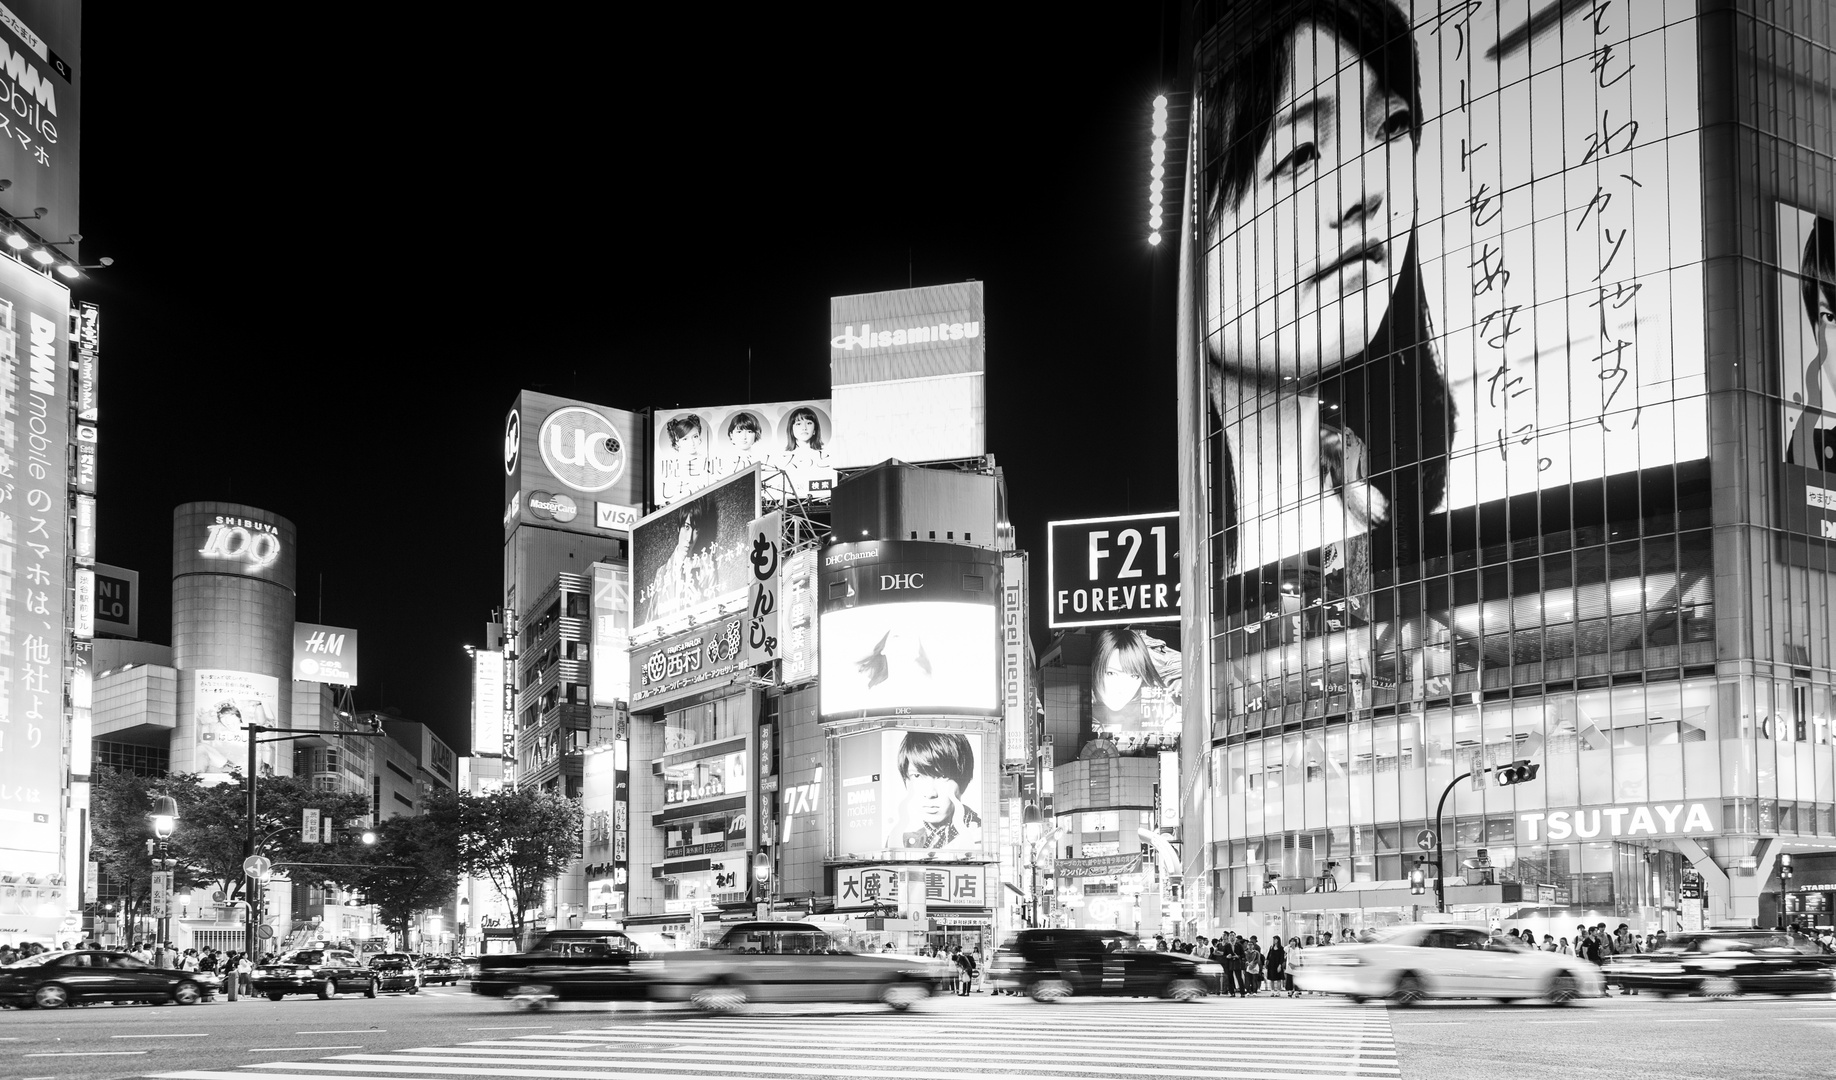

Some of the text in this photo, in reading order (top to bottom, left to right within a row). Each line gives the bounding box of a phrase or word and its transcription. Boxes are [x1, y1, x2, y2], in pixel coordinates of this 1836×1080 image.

[830, 321, 980, 350] Hisamitsu
[530, 499, 577, 514] MasterCard
[602, 509, 636, 526] VISA
[216, 516, 279, 536] SHIBUYA
[198, 524, 281, 573] 109
[826, 549, 879, 567] DHC Channel
[1089, 526, 1166, 581] F21
[880, 573, 925, 591] DHC
[750, 532, 778, 657] もんじゃ
[1058, 583, 1169, 615] FOREVER
[305, 631, 346, 657] H&M
[1006, 579, 1021, 709] Taisei neon
[895, 706, 912, 715] DHC
[667, 781, 724, 803] Euphoria
[847, 788, 876, 805] DMM
[847, 803, 876, 817] mobile
[1520, 803, 1714, 841] TSUTAYA
